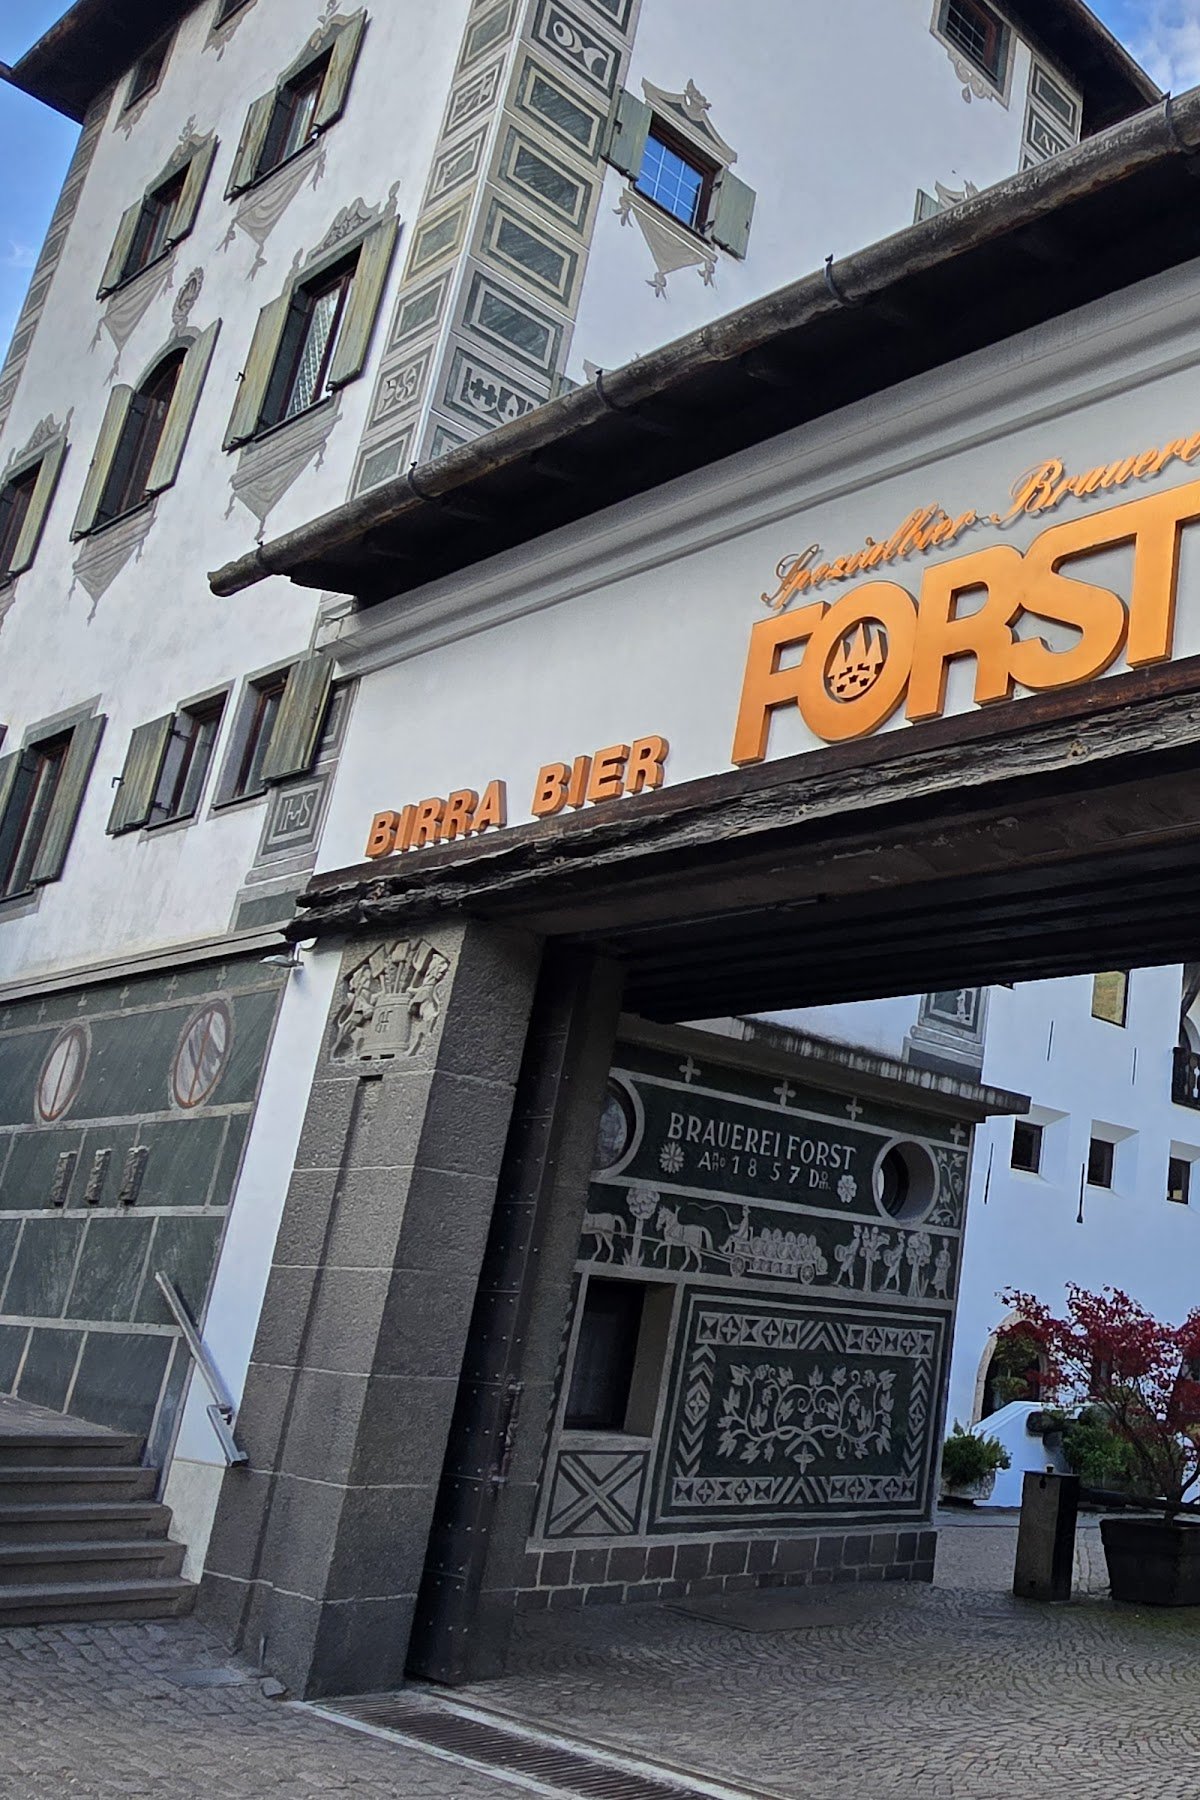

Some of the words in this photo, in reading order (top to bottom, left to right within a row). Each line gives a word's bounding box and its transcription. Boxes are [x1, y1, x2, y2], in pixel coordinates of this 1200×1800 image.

[364, 779, 507, 859] BIRRA
[531, 734, 670, 818] BIER
[667, 1112, 781, 1158] BRAUEREI
[786, 1135, 857, 1170] FORST
[731, 1155, 801, 1184] 1857
